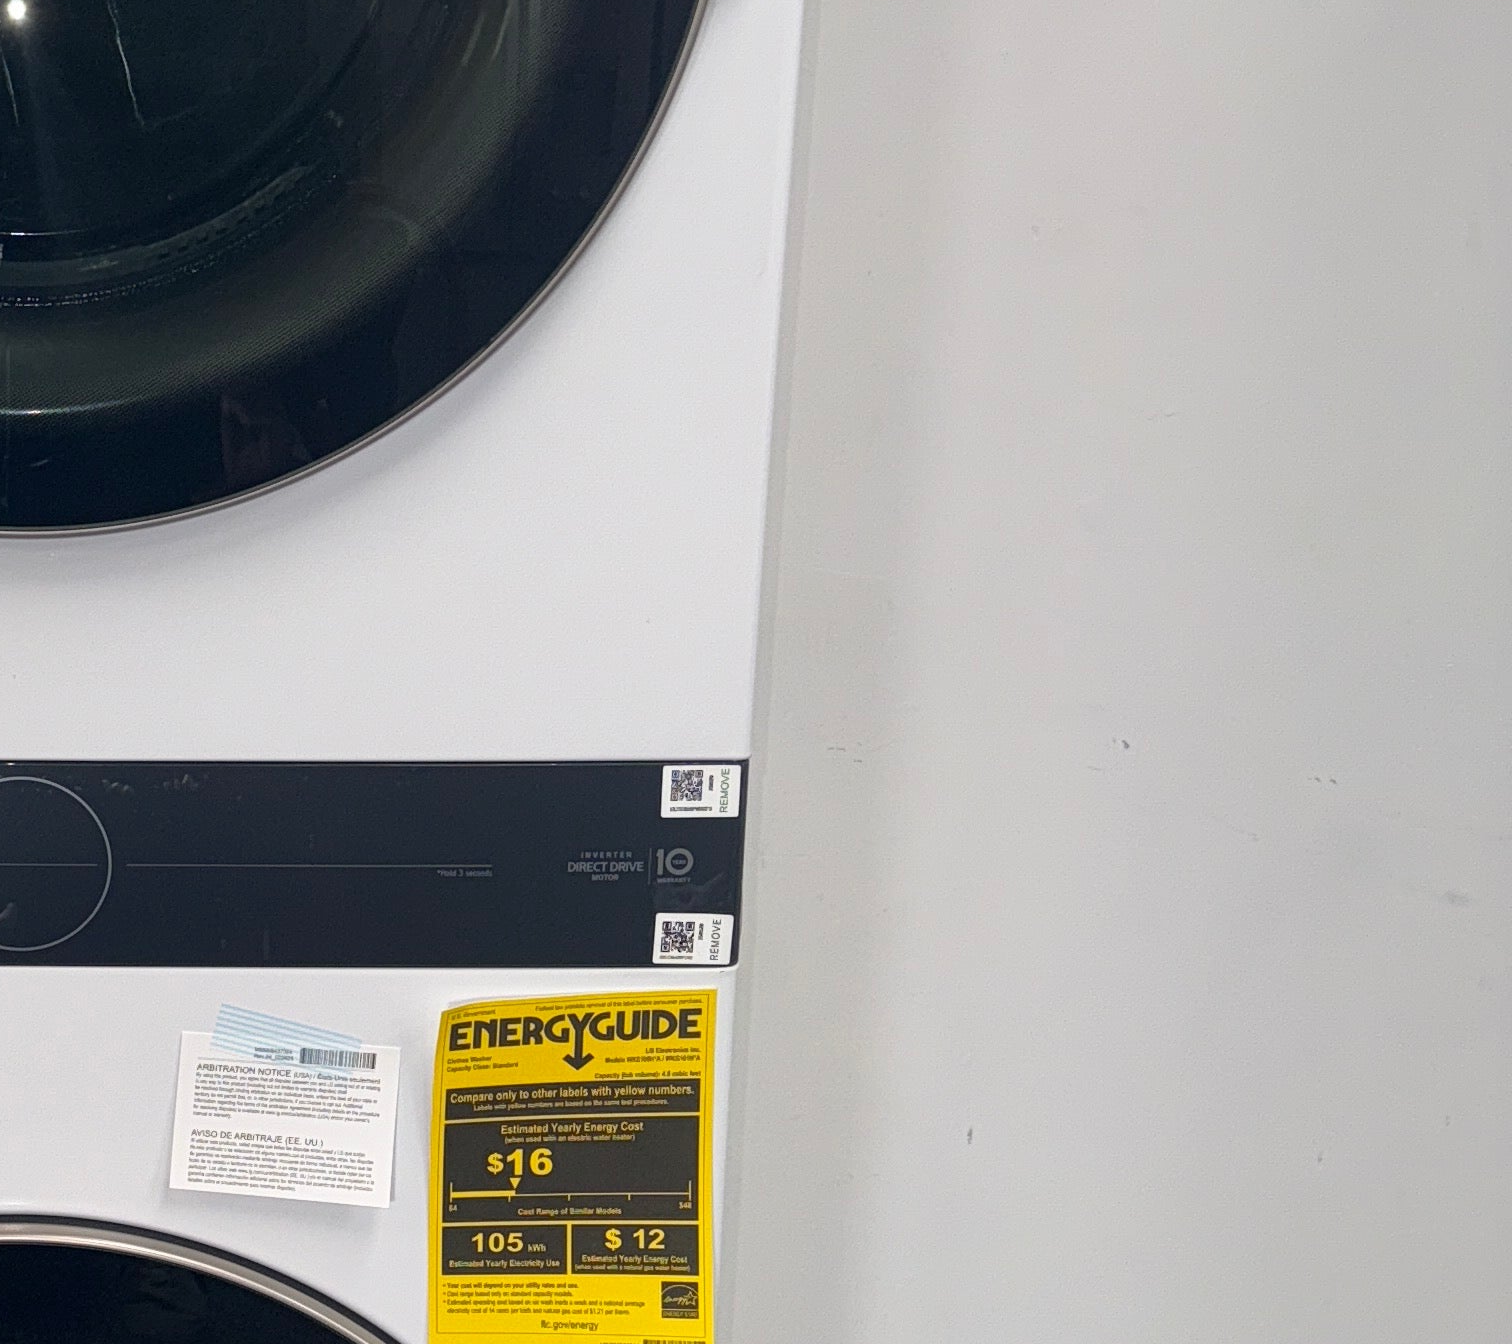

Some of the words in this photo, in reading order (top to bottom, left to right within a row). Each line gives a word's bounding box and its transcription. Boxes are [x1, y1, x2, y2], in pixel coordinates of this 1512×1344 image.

[719, 768, 730, 813] REMOVE
[581, 851, 633, 859] INVERTER
[656, 847, 694, 876] 10
[568, 861, 608, 872] DIRECT
[610, 861, 645, 872] DRIVE
[591, 873, 619, 881] MOTOR
[709, 918, 722, 961] REMOVE
[449, 1008, 702, 1052] ENERGYGUIDE
[196, 1063, 256, 1075] ARBITRATION
[257, 1067, 292, 1078] NOTICE
[450, 1092, 493, 1104] Compare
[496, 1090, 517, 1102] only
[520, 1090, 529, 1099] to
[531, 1088, 557, 1098] other
[559, 1087, 588, 1097] labels
[591, 1085, 611, 1096] with
[614, 1085, 645, 1098] yellow
[648, 1084, 695, 1096] numbers.
[191, 1129, 218, 1138] AVISO
[219, 1131, 233, 1140] DE
[234, 1132, 283, 1143] ARBITRAJE
[501, 1124, 548, 1134] Estimated
[551, 1122, 581, 1134] Yearly
[584, 1122, 618, 1133] Energy
[620, 1121, 644, 1131] Cost
[487, 1147, 553, 1176] $16
[471, 1232, 524, 1253] 105
[527, 1244, 546, 1253] kWh
[633, 1229, 665, 1249] 12
[448, 1260, 484, 1268] Estimated
[485, 1259, 508, 1269] Yearly
[509, 1259, 544, 1268] Electricity
[546, 1259, 560, 1267] Use
[581, 1255, 617, 1263] Estimated
[618, 1254, 642, 1264] Yearly
[643, 1255, 669, 1265] Energy
[670, 1255, 688, 1263] Cost
